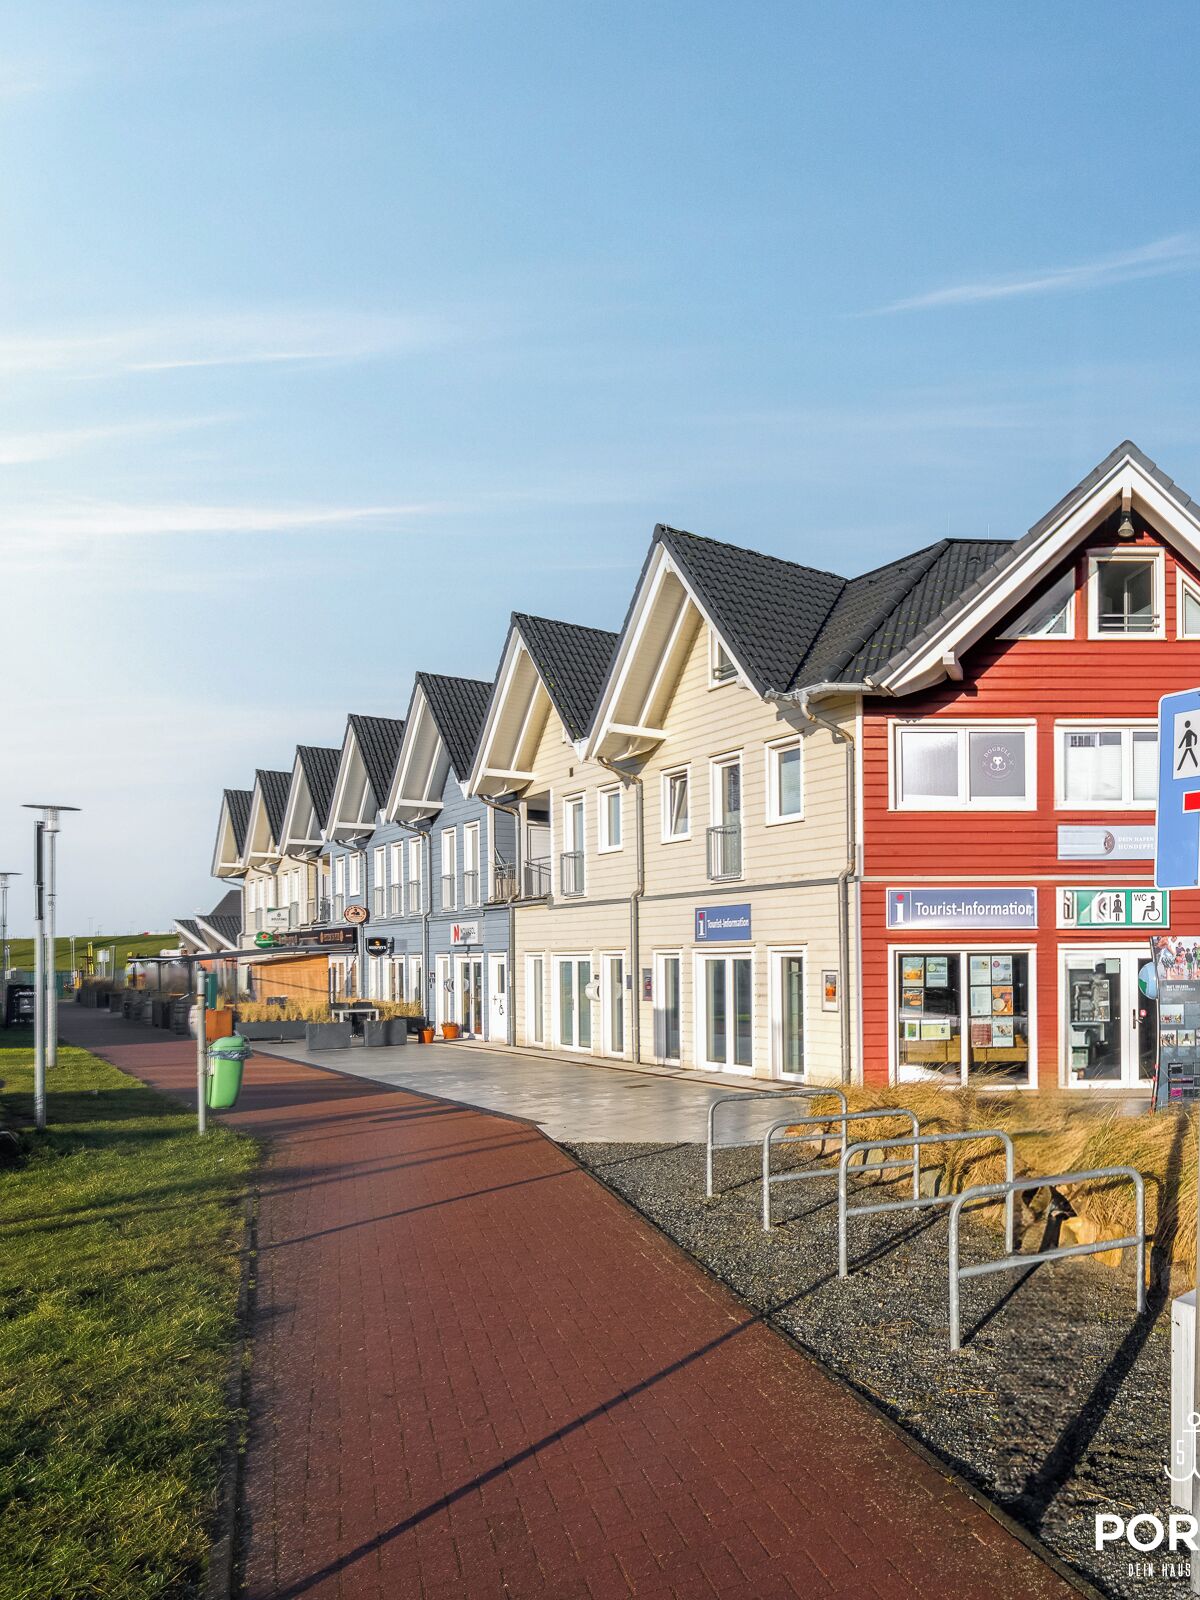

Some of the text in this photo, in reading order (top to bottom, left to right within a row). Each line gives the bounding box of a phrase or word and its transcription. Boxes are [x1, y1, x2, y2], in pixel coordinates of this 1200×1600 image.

[1133, 894, 1147, 902] WC
[915, 901, 1031, 916] Tourist-Information
[707, 917, 749, 928] Tourist-Information
